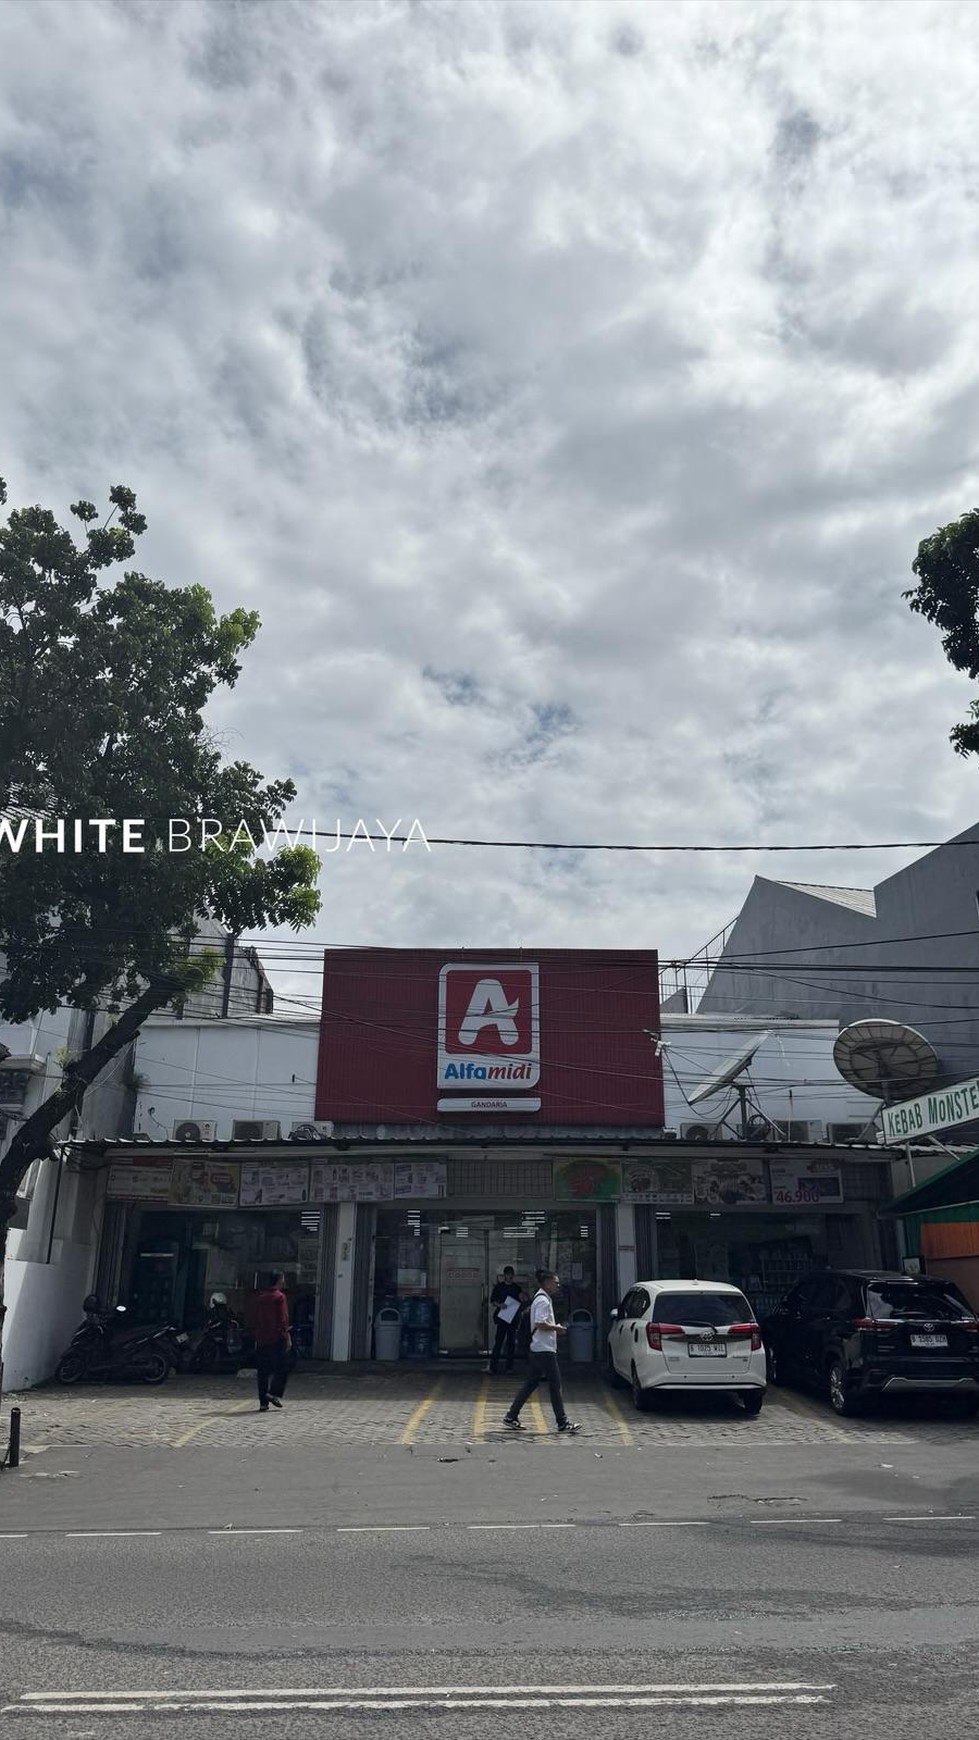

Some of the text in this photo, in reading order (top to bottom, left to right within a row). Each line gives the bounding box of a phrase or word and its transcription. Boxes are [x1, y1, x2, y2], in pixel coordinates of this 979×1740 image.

[444, 1062, 532, 1080] Alfamidi
[470, 1101, 508, 1109] GANDARIA
[887, 1079, 979, 1137] KEBAB MONSTE
[775, 1190, 820, 1203] 46.900
